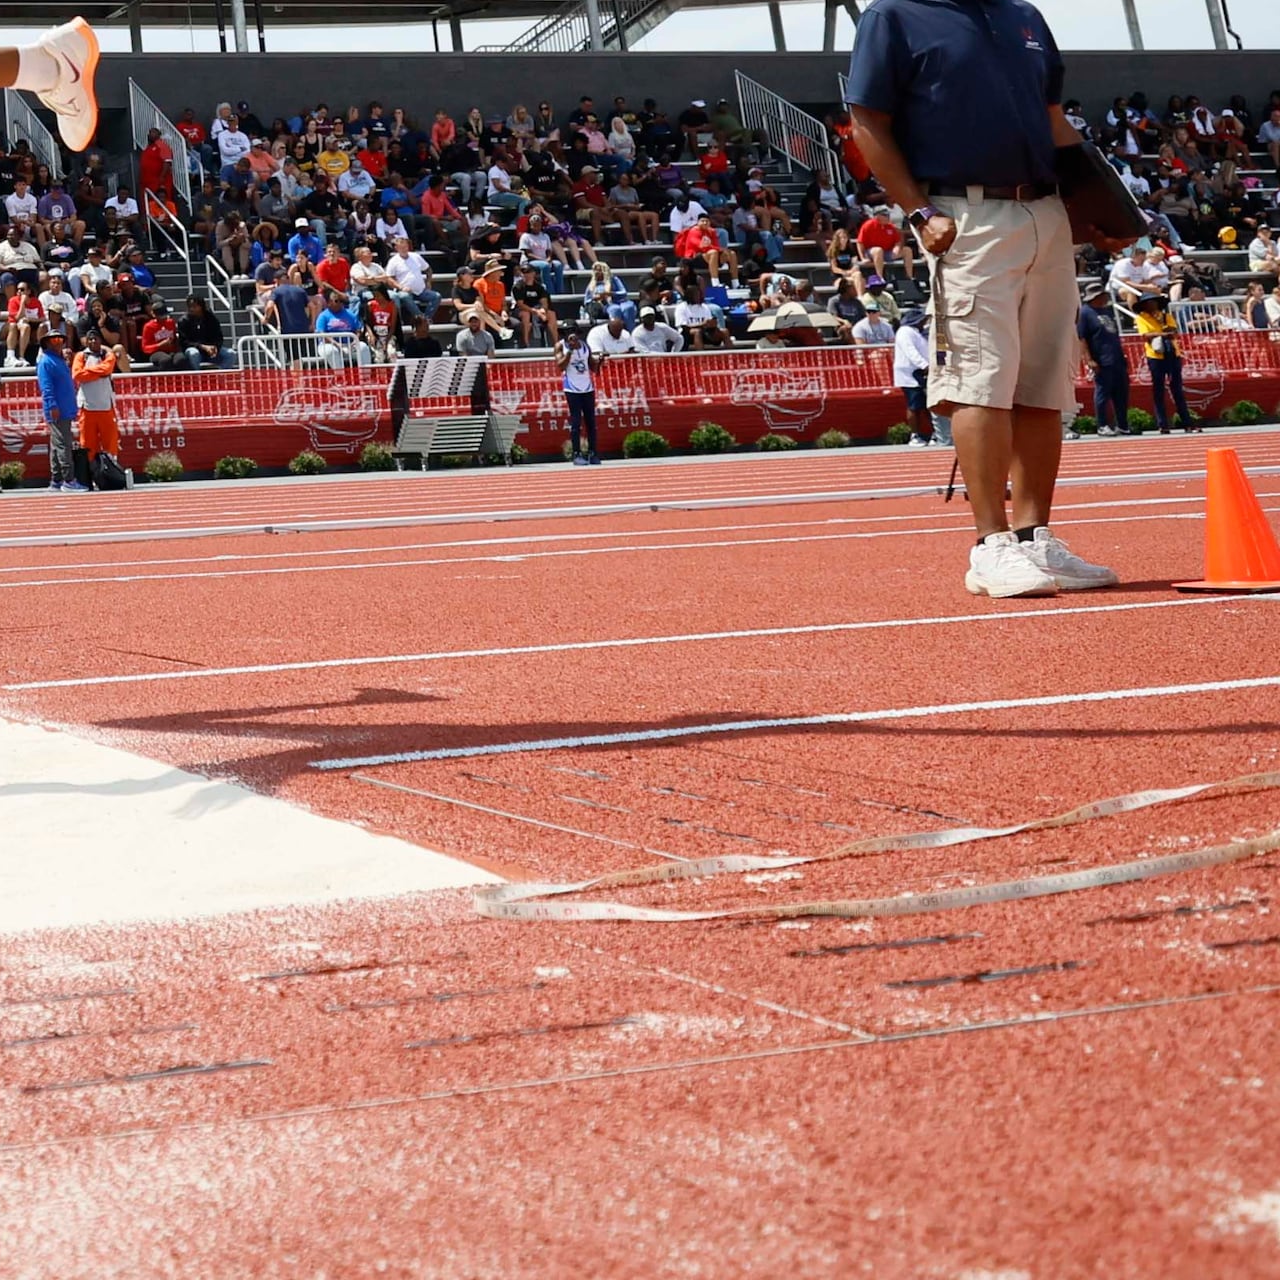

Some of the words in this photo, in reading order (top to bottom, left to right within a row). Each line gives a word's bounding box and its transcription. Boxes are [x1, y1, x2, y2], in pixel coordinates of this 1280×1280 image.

[536, 387, 651, 418] ATANTA
[537, 419, 573, 432] TRA
[607, 415, 652, 428] CLUB
[136, 436, 187, 450] CLUB
